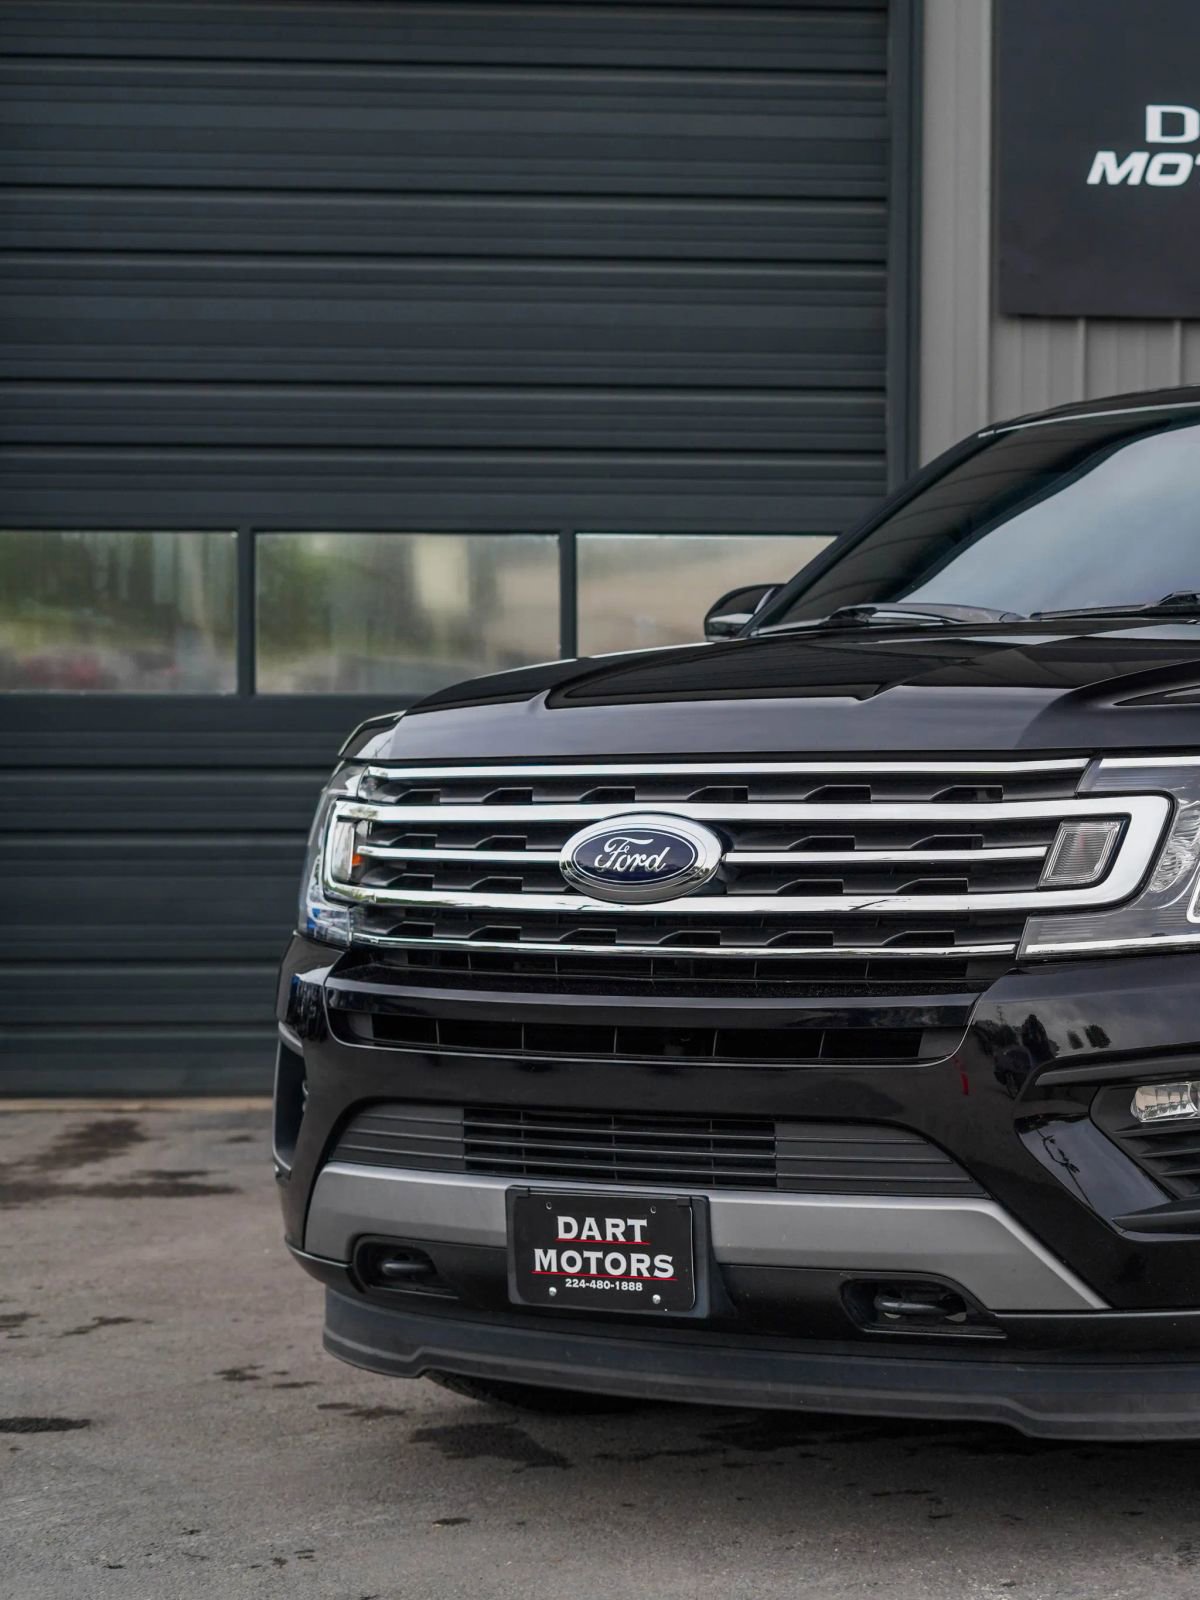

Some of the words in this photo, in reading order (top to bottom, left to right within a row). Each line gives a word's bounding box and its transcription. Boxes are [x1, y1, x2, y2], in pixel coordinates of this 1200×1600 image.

[594, 836, 671, 873] Ford
[557, 1216, 648, 1242] DART
[534, 1249, 675, 1278] MOTORS
[565, 1278, 643, 1291] 224-480-1888
